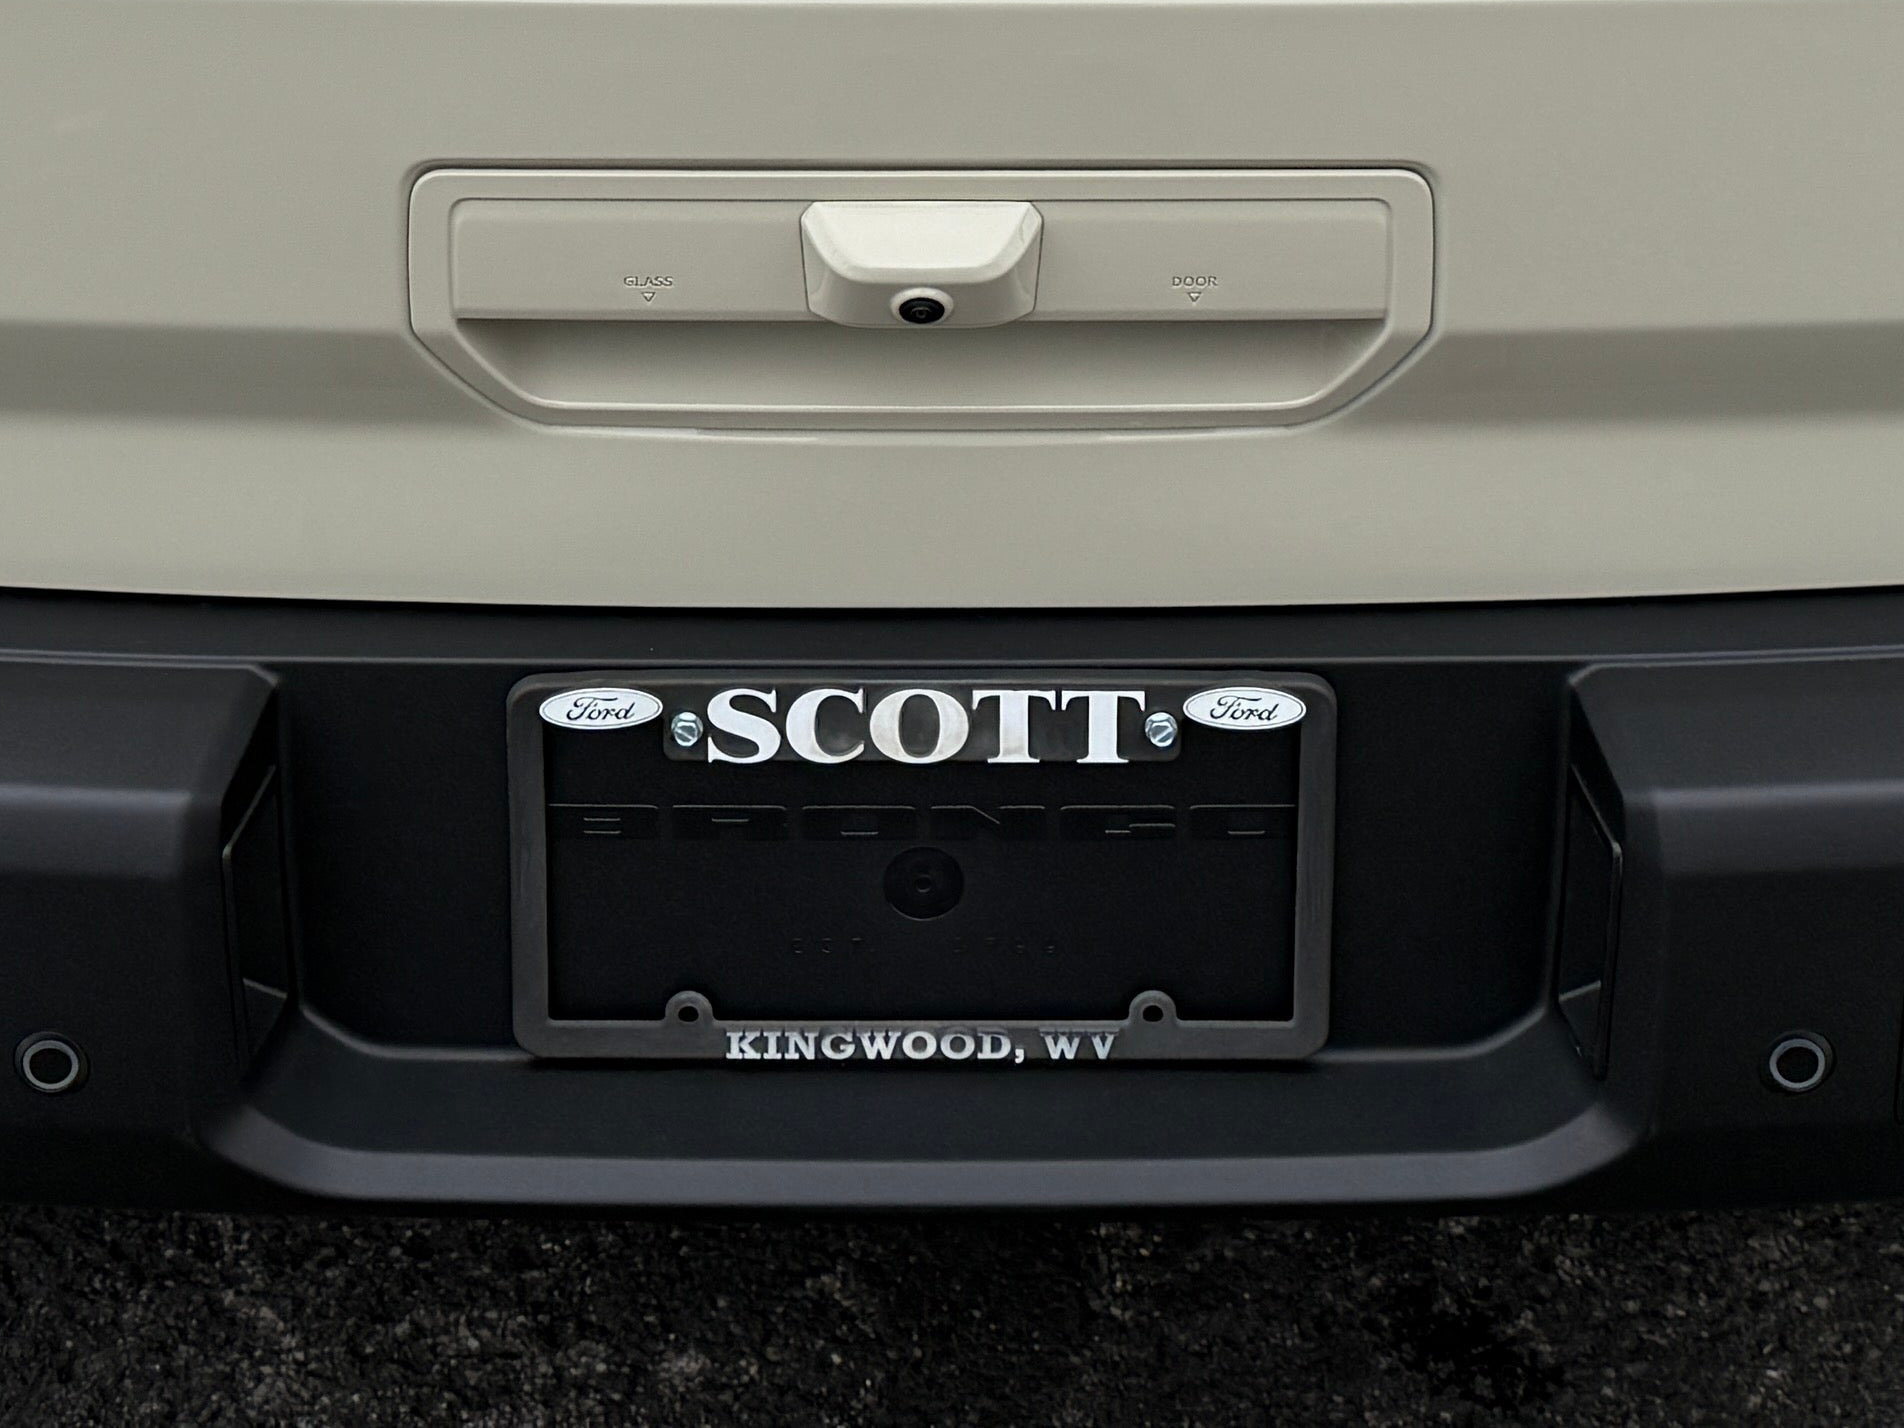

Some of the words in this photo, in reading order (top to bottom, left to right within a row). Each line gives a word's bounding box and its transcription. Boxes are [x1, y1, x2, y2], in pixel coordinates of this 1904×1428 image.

[623, 275, 674, 287] GLASS
[1171, 275, 1218, 287] DOOR
[566, 696, 636, 721] Ford
[1209, 694, 1280, 721] Ford
[706, 687, 1147, 765] SCOTT
[725, 1028, 1026, 1064] KINGWOOD,
[1039, 1027, 1120, 1060] WV
